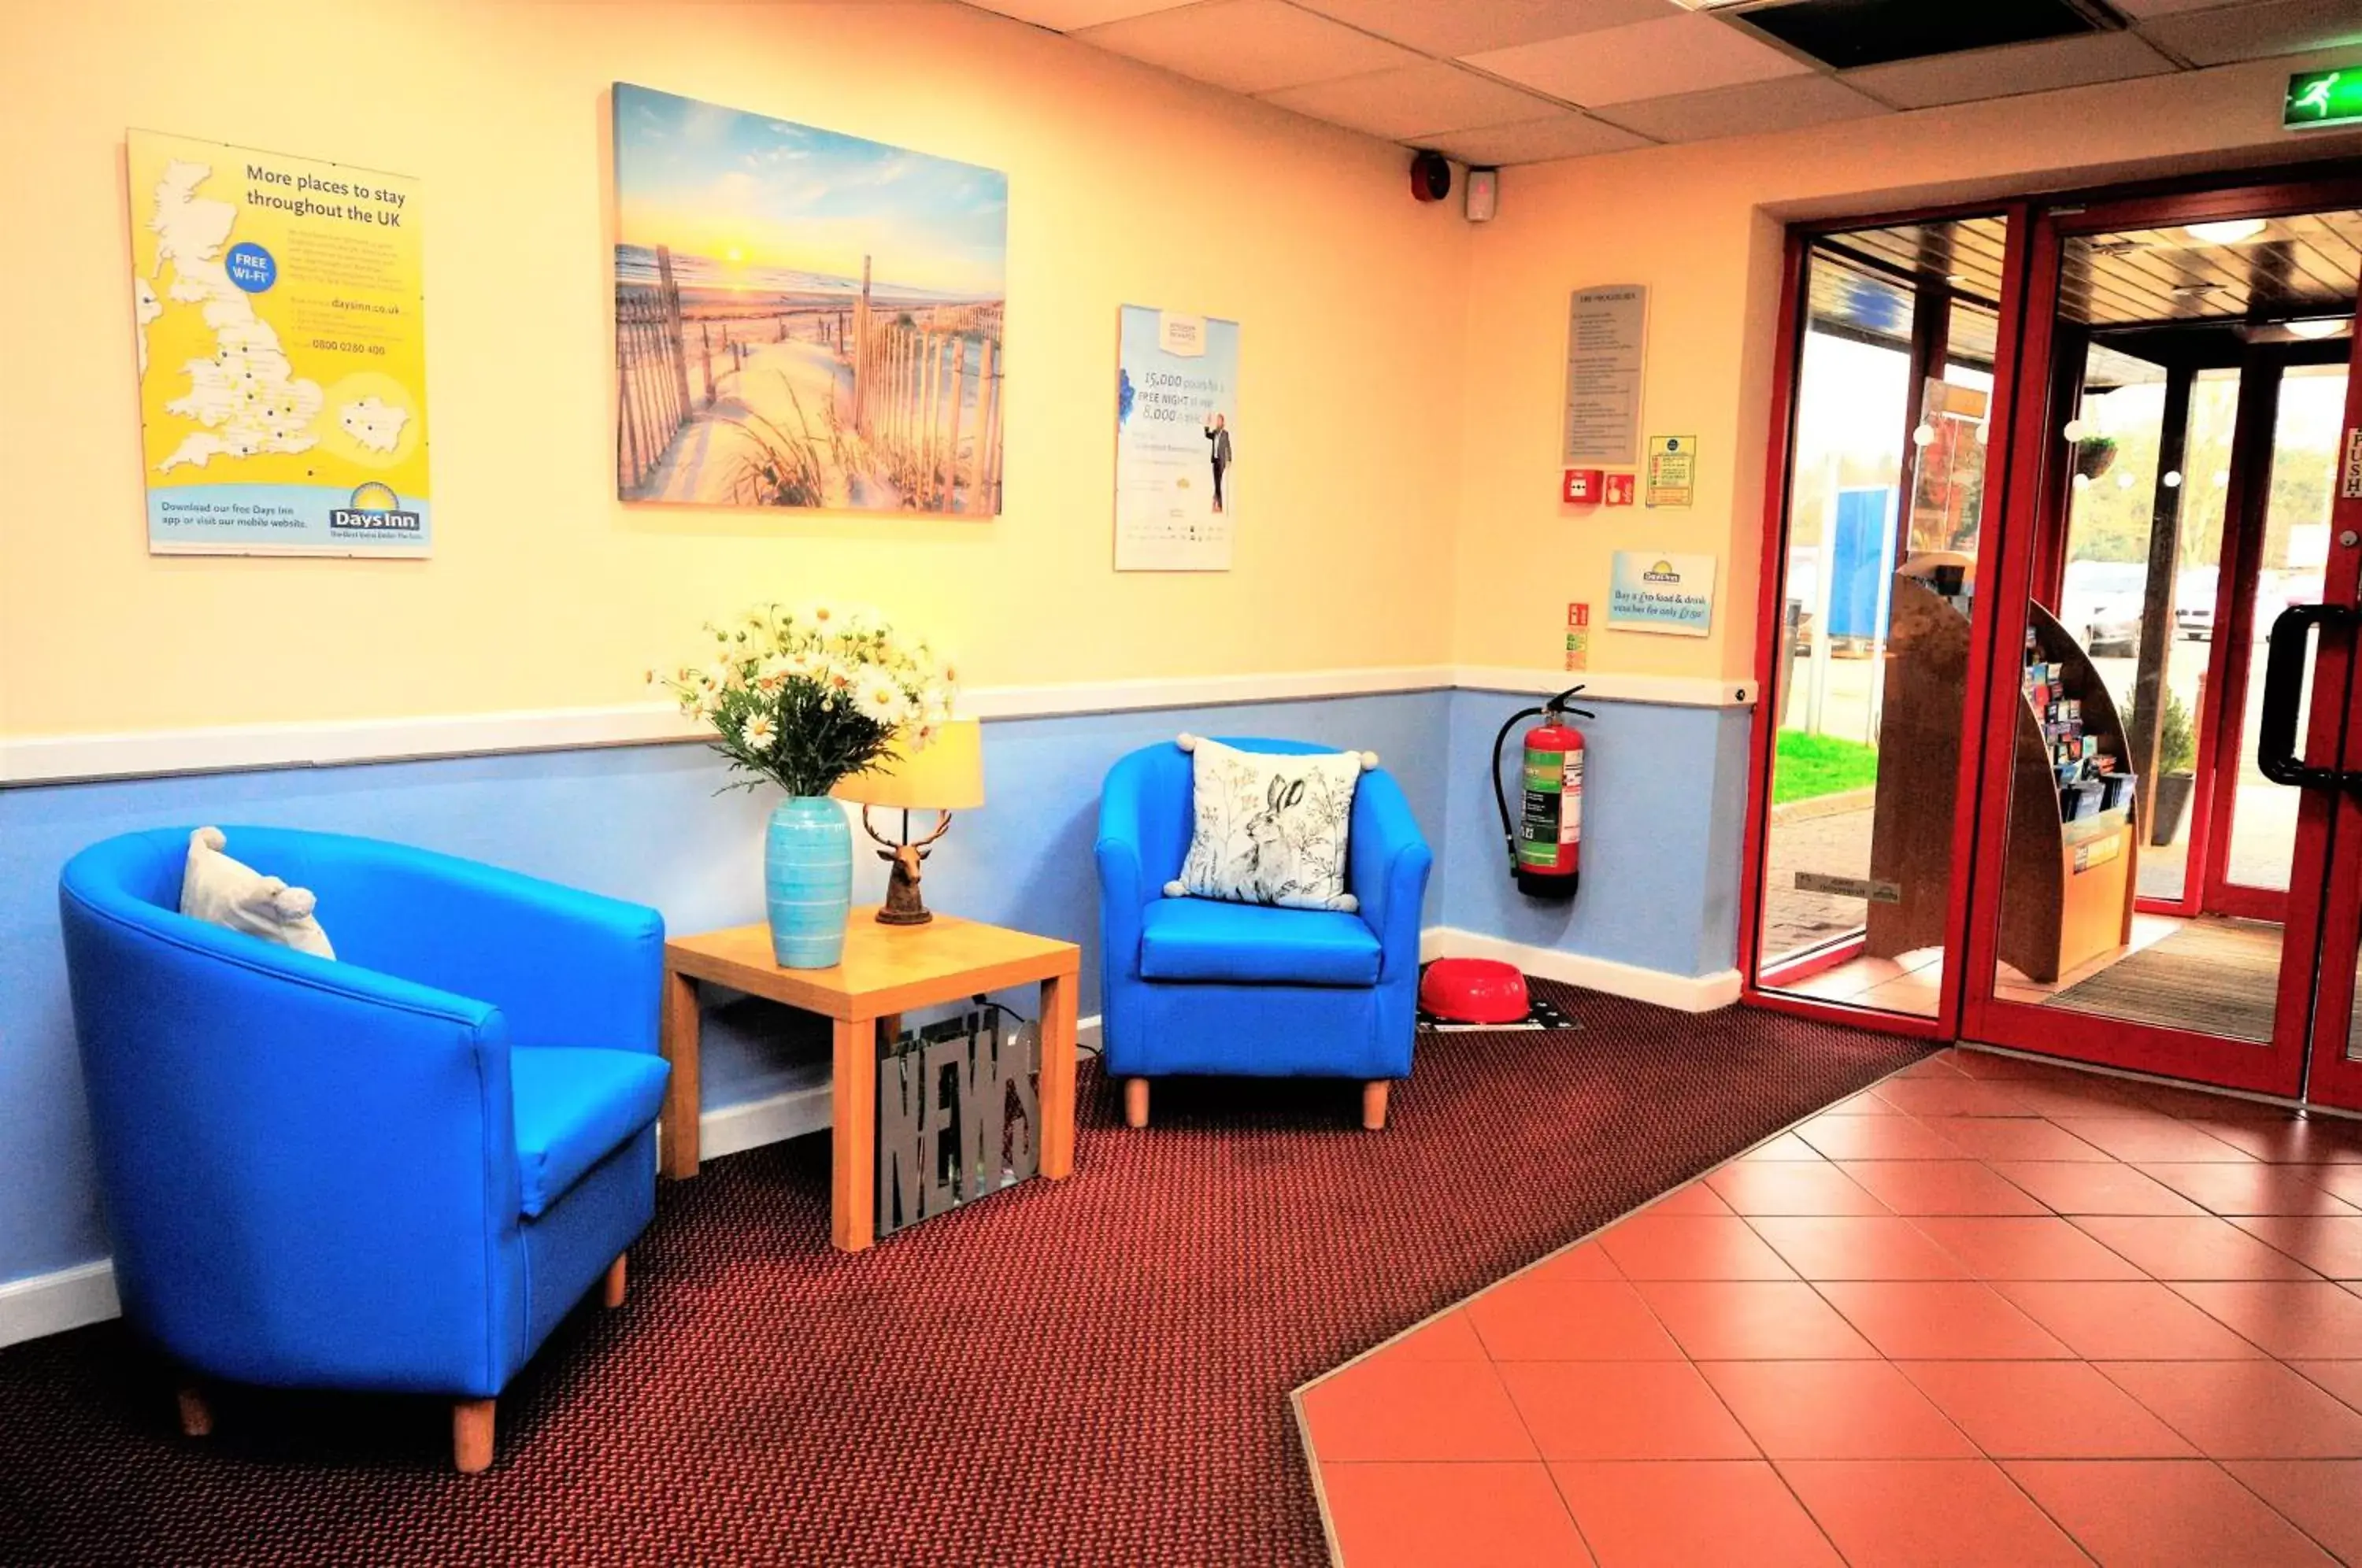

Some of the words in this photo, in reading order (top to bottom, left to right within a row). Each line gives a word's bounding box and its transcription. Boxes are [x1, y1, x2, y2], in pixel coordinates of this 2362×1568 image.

[246, 165, 291, 186] More
[298, 173, 349, 196] places
[354, 185, 369, 199] to
[375, 189, 405, 209] stay
[247, 189, 342, 216] throughout
[347, 205, 372, 223] the
[378, 210, 401, 227] UK
[235, 253, 267, 269] FREE
[331, 297, 399, 314] daysinn.co.uk
[313, 339, 338, 350] 0800
[1138, 391, 1160, 404] FREE
[1161, 394, 1189, 405] NIGHT
[161, 501, 210, 512] Download
[232, 503, 250, 514] free
[253, 505, 276, 516] Days
[278, 506, 294, 515] Inn
[162, 516, 180, 526] app
[197, 516, 217, 525] visit
[218, 517, 235, 526] our
[237, 516, 268, 527] mobile
[335, 511, 383, 527] Days
[384, 512, 415, 527] Inn
[1615, 589, 1629, 601] Buy
[1675, 594, 1683, 604] &
[1659, 607, 1677, 618] only
